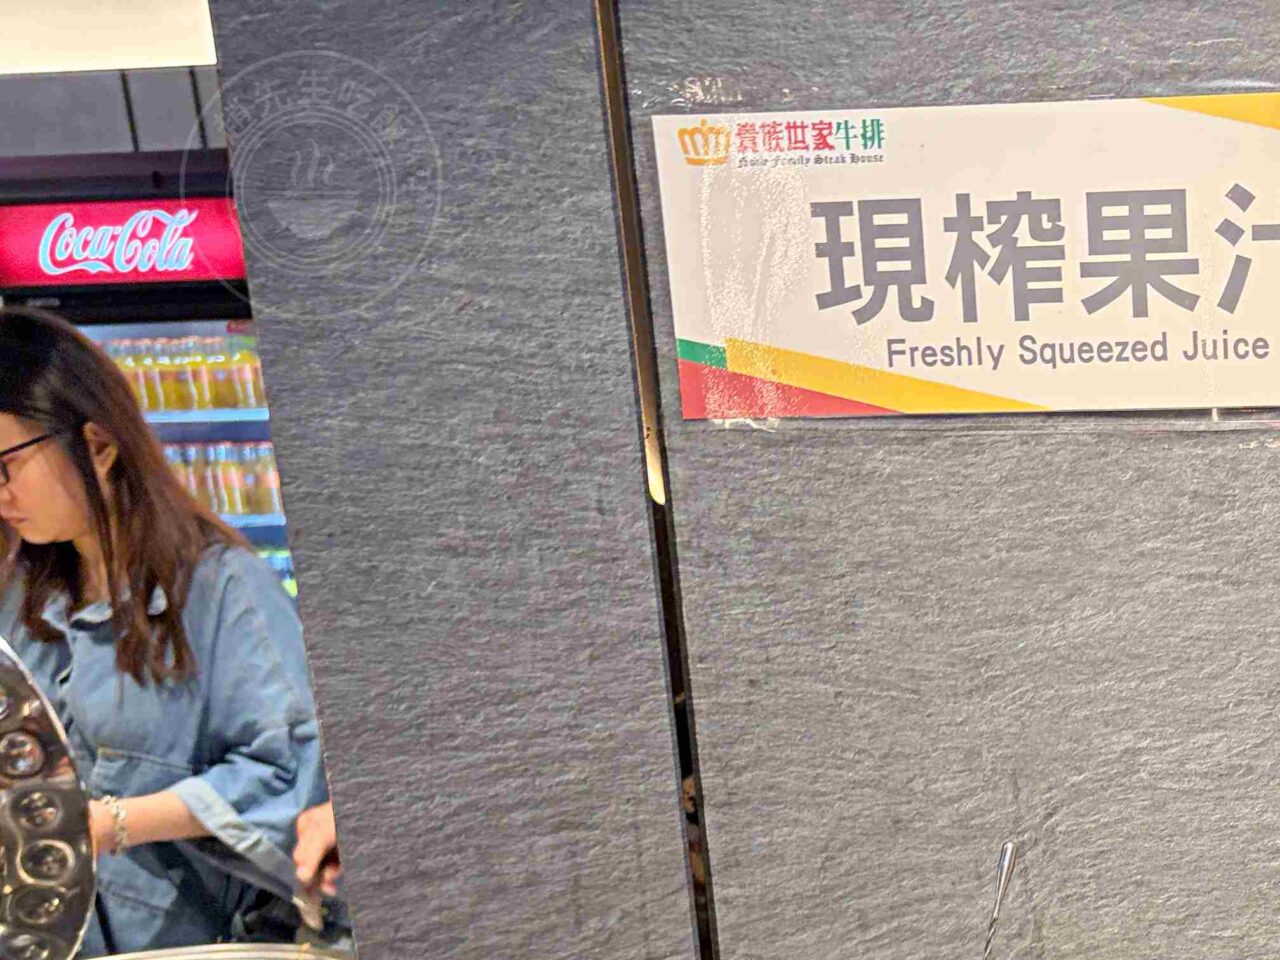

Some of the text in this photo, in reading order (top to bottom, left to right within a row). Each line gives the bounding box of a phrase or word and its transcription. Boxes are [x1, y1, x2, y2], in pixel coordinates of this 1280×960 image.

[735, 118, 885, 153] 貴族世家牛排
[886, 330, 1271, 371] Freshly Squeezed Juice
